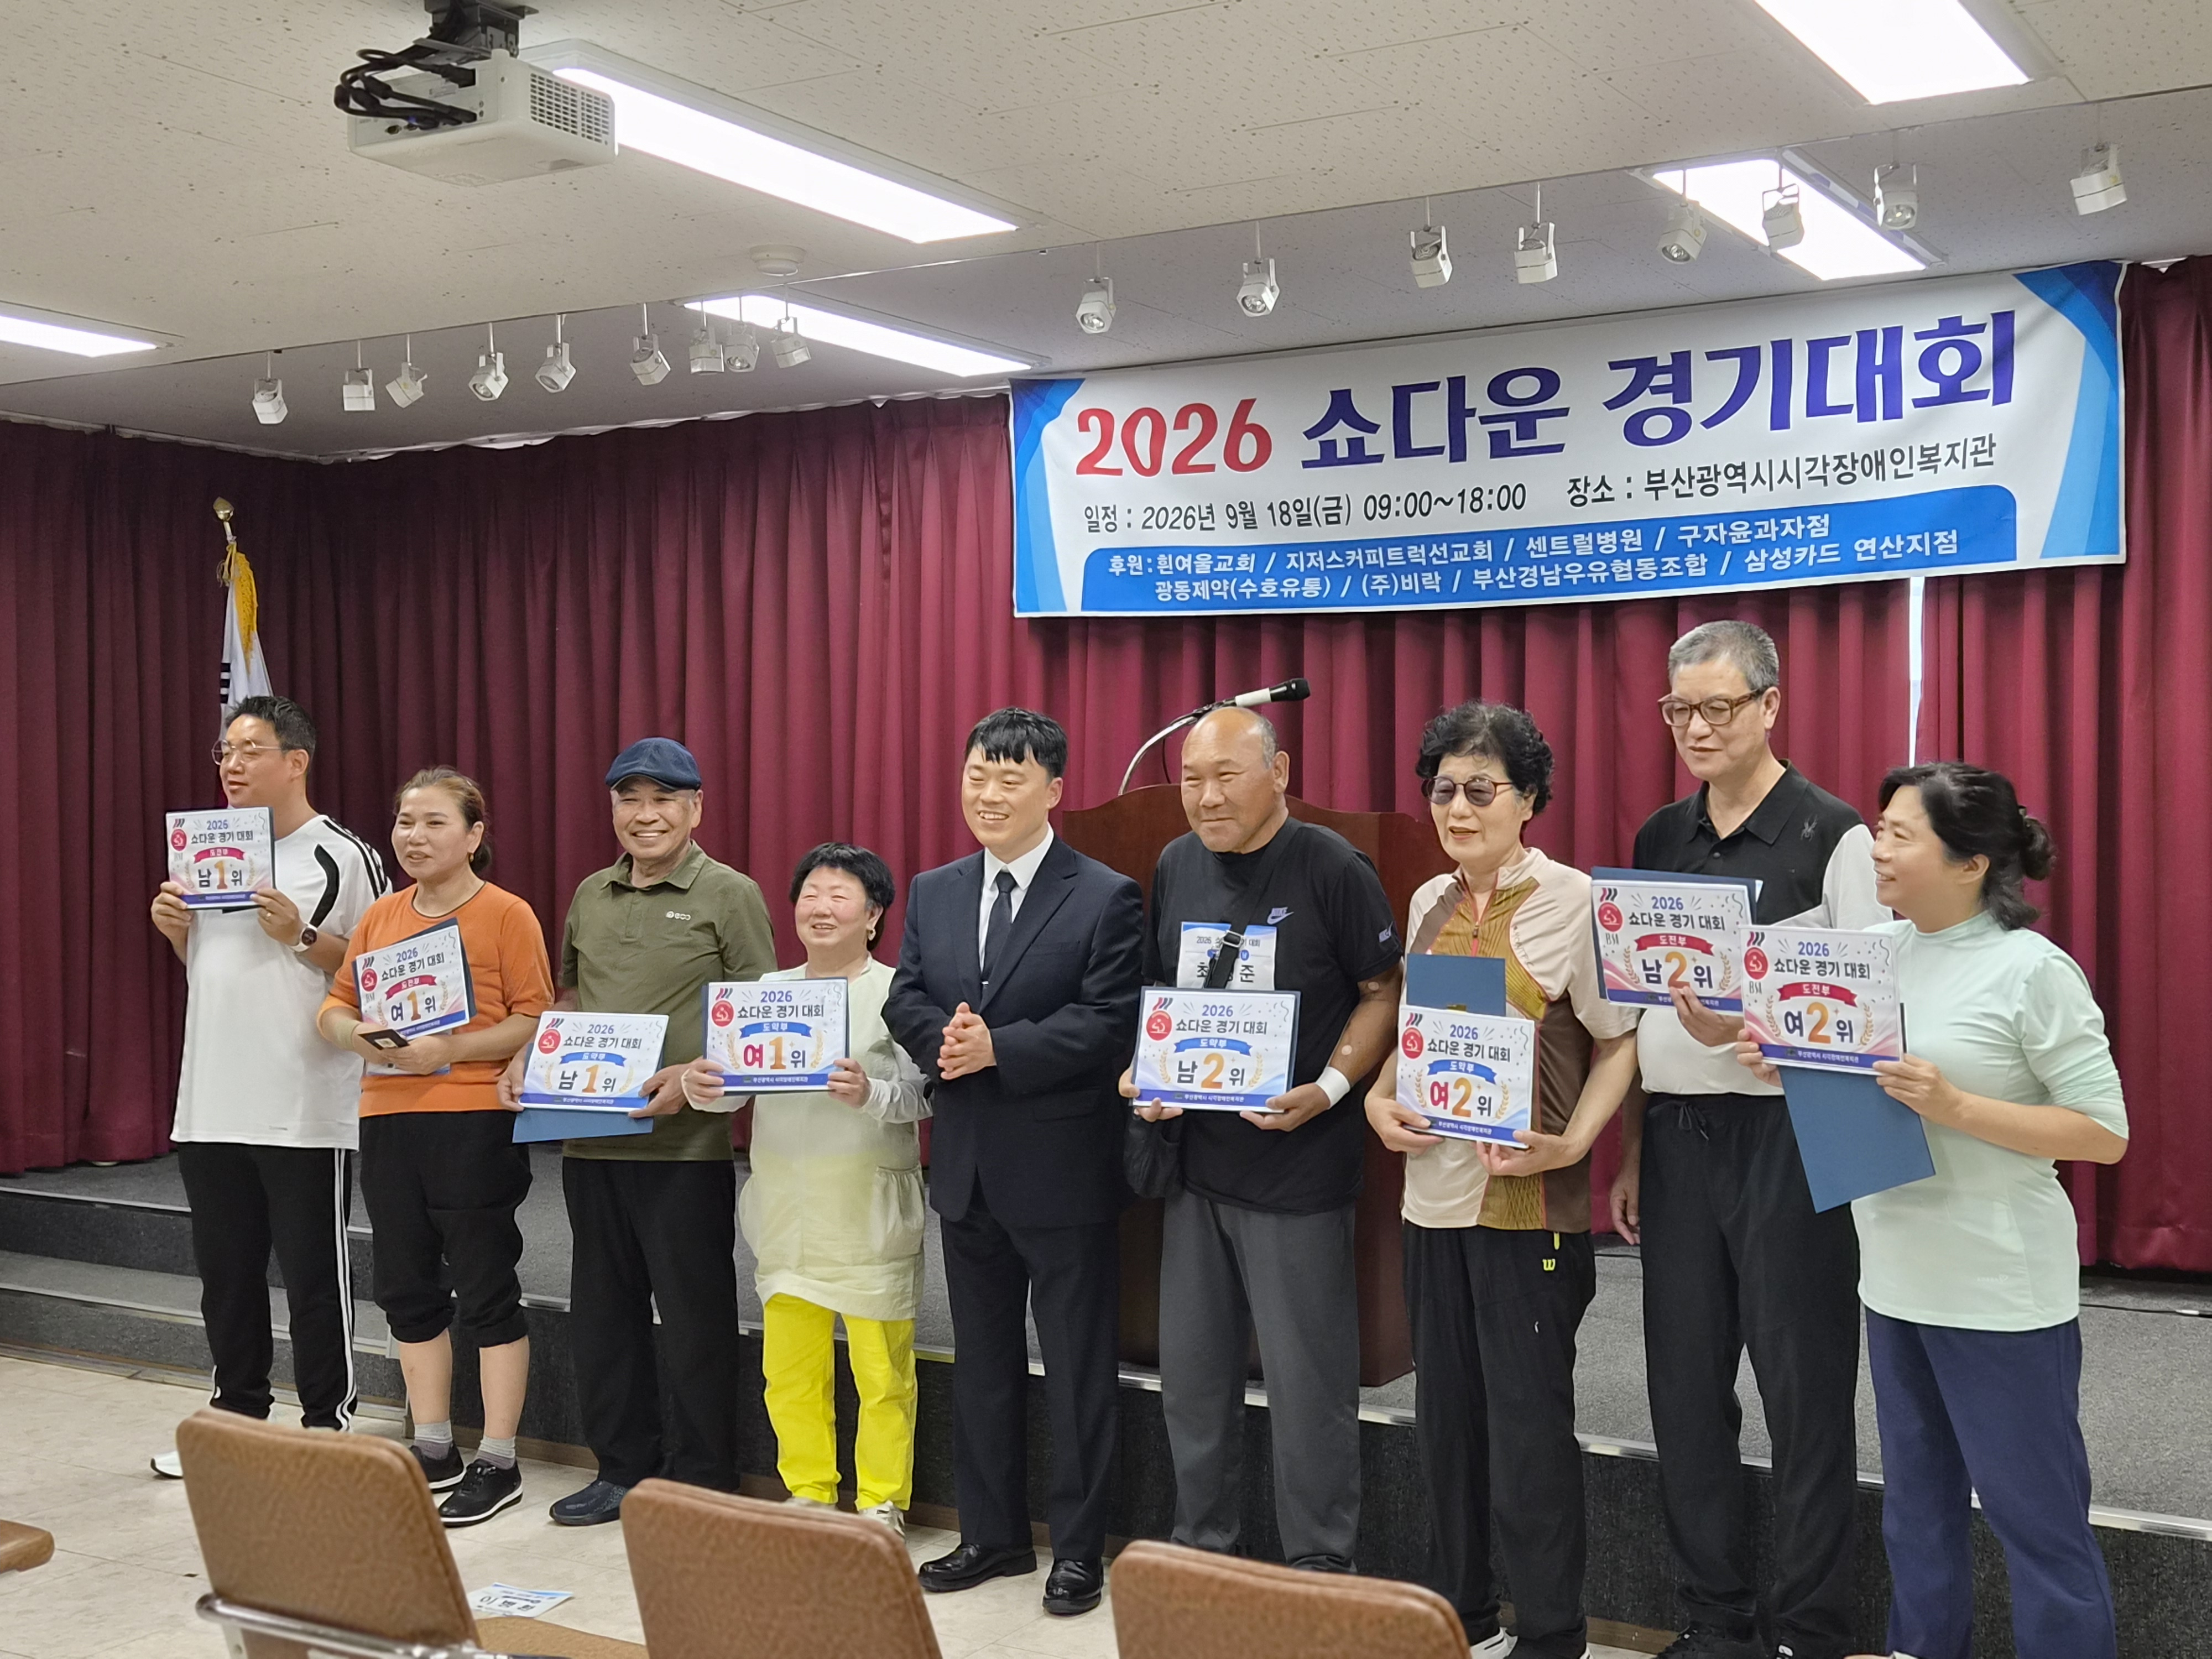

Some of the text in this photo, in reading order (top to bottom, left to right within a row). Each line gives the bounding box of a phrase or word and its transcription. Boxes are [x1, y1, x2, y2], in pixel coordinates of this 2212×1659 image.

[1076, 310, 2015, 477] 2026 쇼다운 경기대회
[1084, 504, 1118, 533] 일정
[1141, 503, 1216, 532] 2026년
[1225, 500, 1259, 530] 9월
[1266, 493, 1351, 528] 18일(금)
[1363, 483, 1526, 521] 09:00~18:00
[1567, 474, 1615, 508] 장소
[1644, 433, 1997, 501] 부산광역시시각장애인복지관
[1286, 539, 1493, 572] 지저스커피트럭선교회
[1525, 528, 1642, 559] 센트럴병원
[1677, 513, 1830, 548] 구자윤과자점
[1155, 576, 1331, 601] 광동제약(수호유통)
[1361, 571, 1442, 597] (주)비락
[1472, 553, 1708, 591] 부산경남우유협동조합
[1744, 543, 1841, 572] 삼성카드
[1854, 529, 1958, 562] 연산지점
[207, 819, 228, 831] 2026
[191, 830, 253, 844] 쇼다운 경기 대회
[1651, 896, 1684, 910] 2026
[1629, 912, 1725, 931] 쇼다운 경기 대회
[397, 947, 419, 963] 2026
[1798, 941, 1830, 957] 2026
[382, 952, 445, 982] 쇼다운 경기 대회
[1774, 958, 1870, 979] 쇼다운 경기 대회
[760, 990, 793, 1003] 2026
[1802, 984, 1830, 995] 도전부
[737, 1004, 824, 1019] 쇼다운 경기 대회
[1202, 1004, 1234, 1017] 2026
[587, 1024, 614, 1035] 2026
[1176, 1019, 1267, 1035] 쇼다운 경기 대회
[1449, 1024, 1478, 1040] 2026
[563, 1036, 642, 1050] 쇼다운 경기 대회
[1199, 1039, 1227, 1048] 도약부
[1427, 1038, 1510, 1062] 쇼다운 경기 대회
[1449, 1061, 1475, 1073] 도약부
